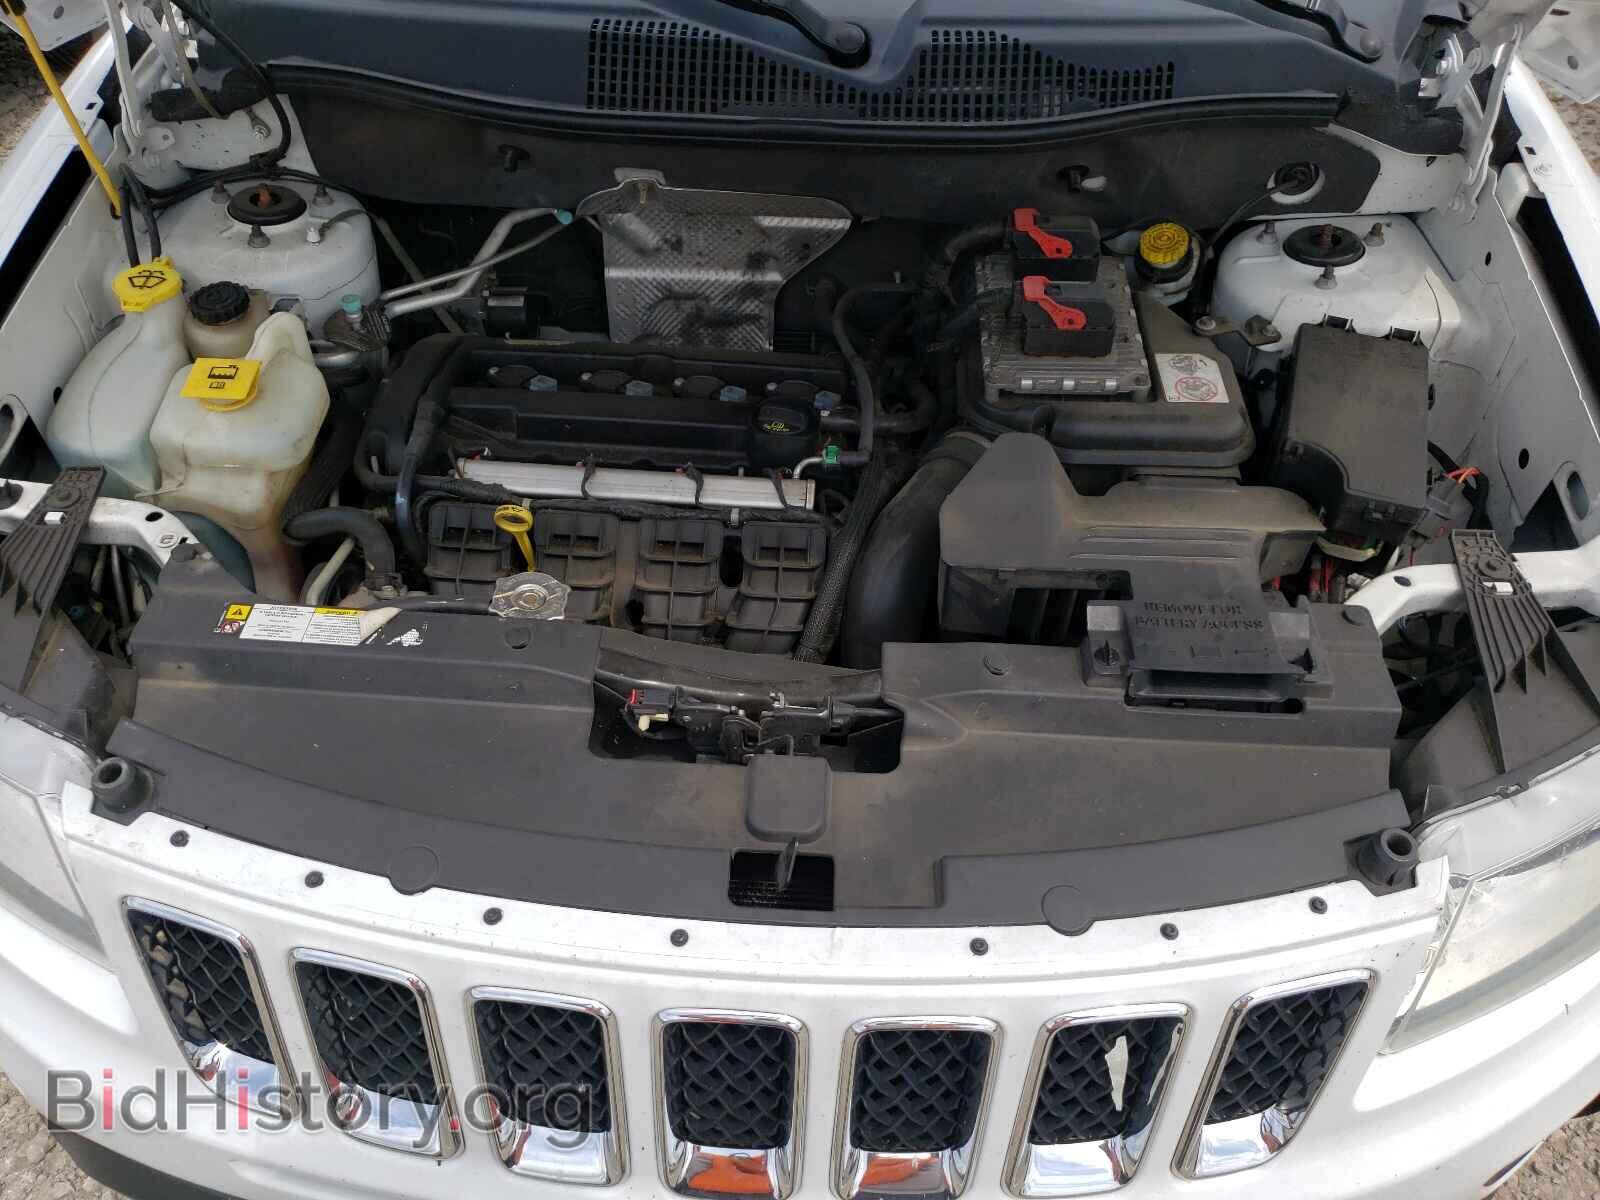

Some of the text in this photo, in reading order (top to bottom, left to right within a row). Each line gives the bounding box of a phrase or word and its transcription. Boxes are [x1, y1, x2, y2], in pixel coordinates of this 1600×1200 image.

[1144, 601, 1243, 615] REMOVE FOR
[1135, 615, 1265, 631] BATTERY ACCESS
